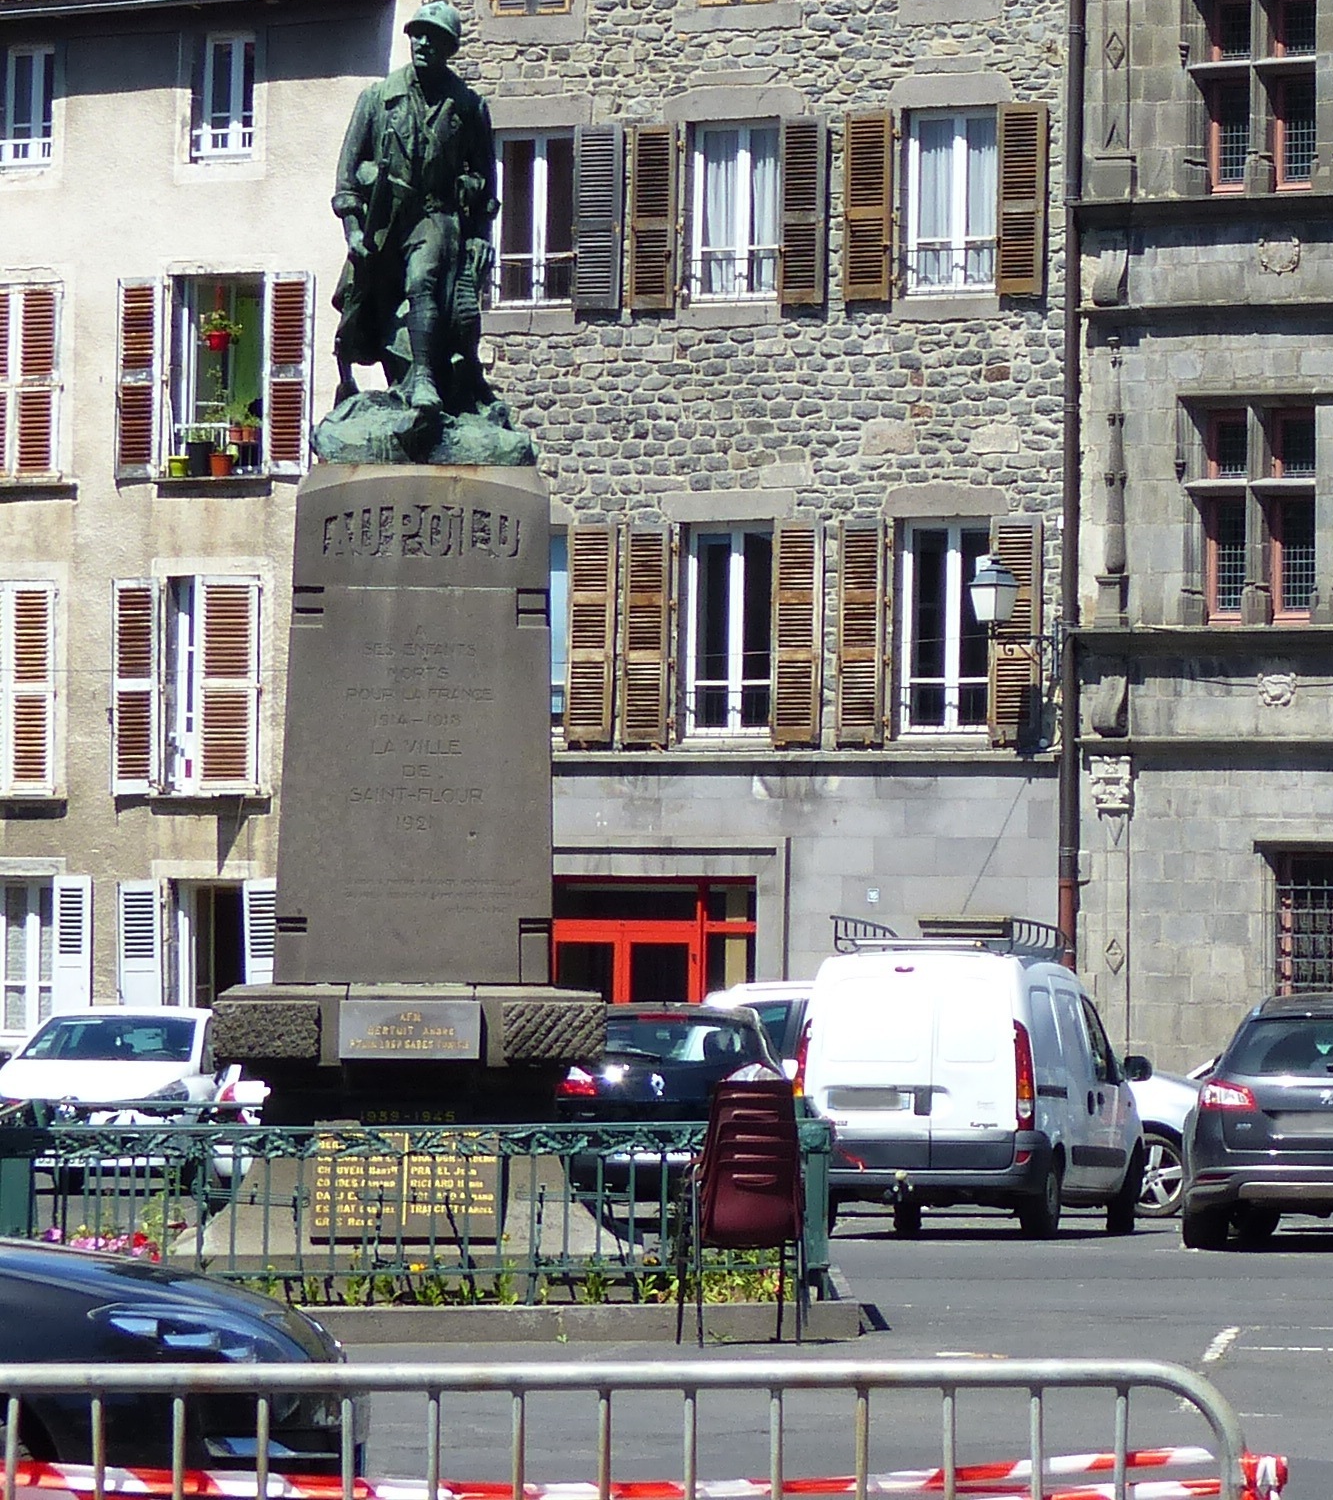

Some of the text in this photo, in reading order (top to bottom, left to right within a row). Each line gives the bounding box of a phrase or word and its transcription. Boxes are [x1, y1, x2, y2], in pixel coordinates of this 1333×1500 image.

[346, 688, 396, 701] POUR
[427, 687, 494, 702] FRANCE
[370, 739, 463, 756] LA VILLE
[348, 786, 484, 804] SAINT-FLOUR
